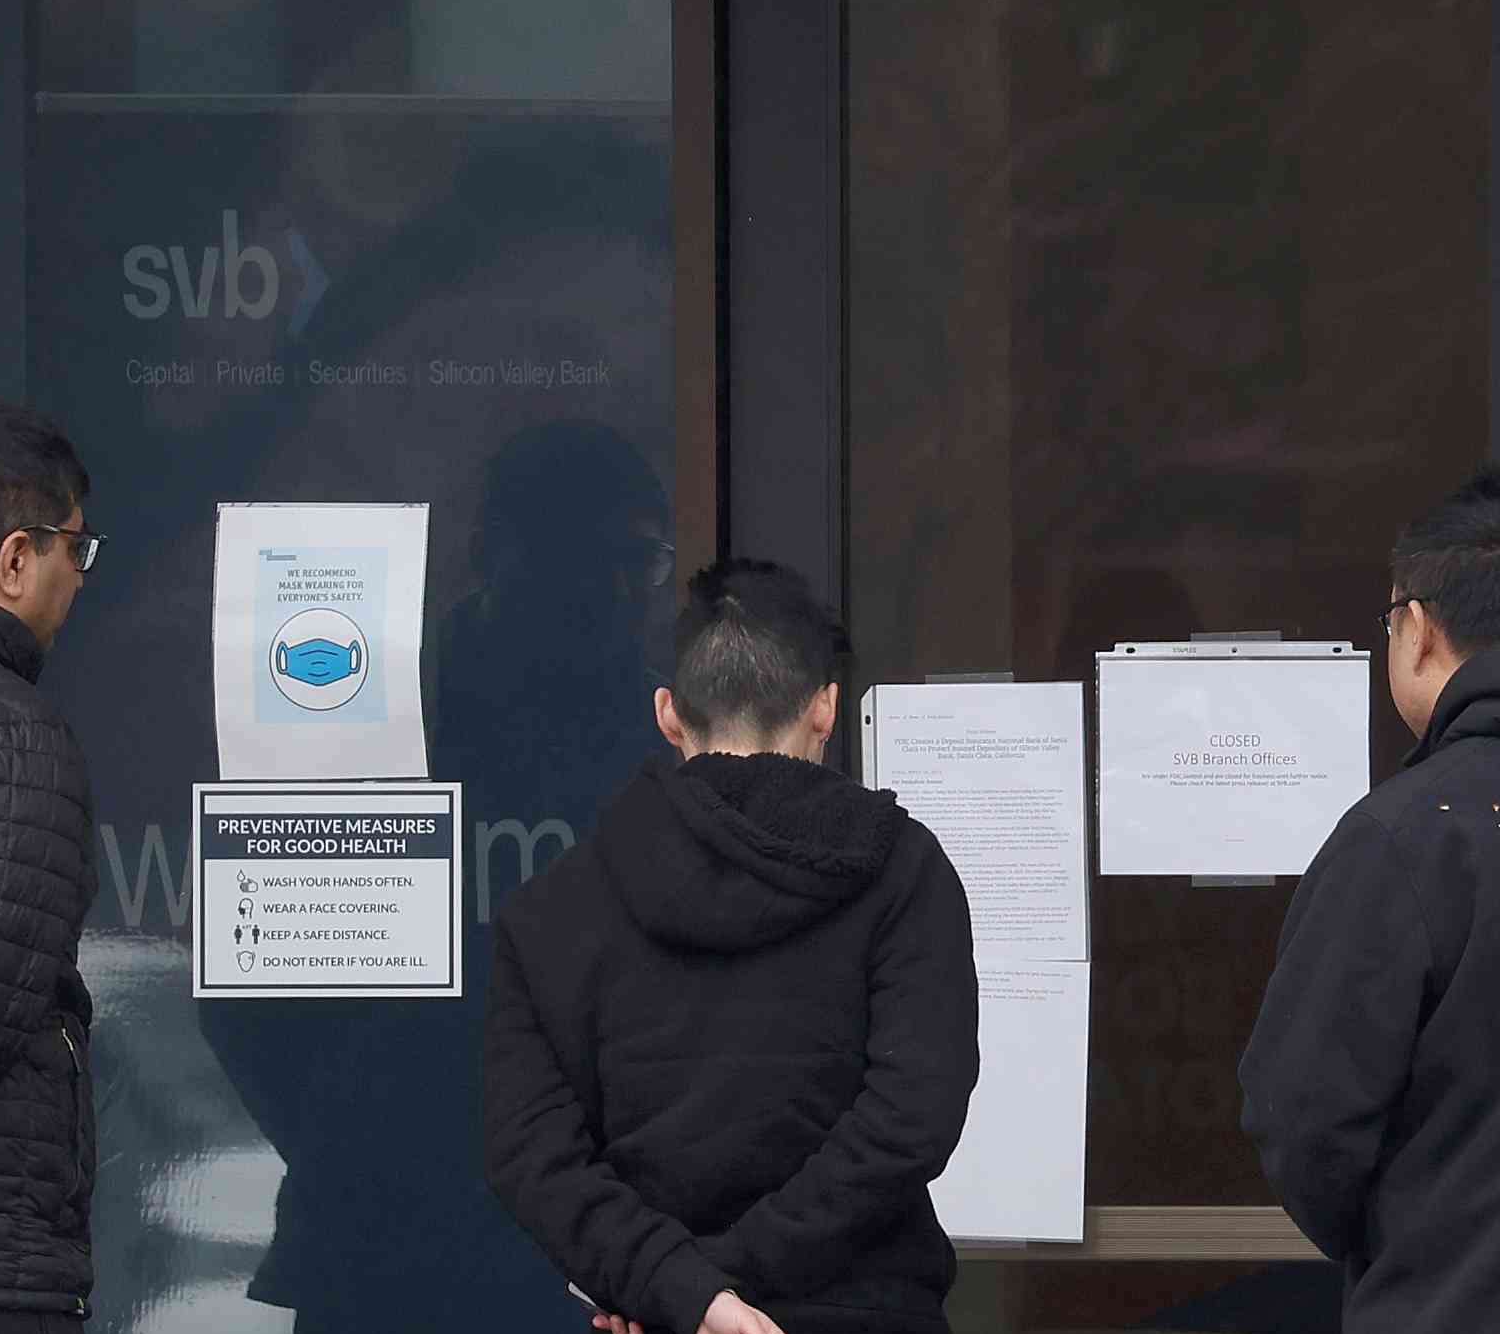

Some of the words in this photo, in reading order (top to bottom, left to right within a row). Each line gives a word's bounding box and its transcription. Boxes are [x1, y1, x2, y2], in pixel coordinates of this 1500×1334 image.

[123, 209, 280, 320] svb
[125, 359, 195, 387] Capital
[216, 360, 285, 385] Private
[308, 360, 407, 385] Securities
[428, 360, 495, 385] Silicon
[500, 360, 555, 389] Valley
[560, 359, 610, 385] Bank
[287, 569, 300, 578] WE
[302, 569, 356, 578] RECOMMEND
[278, 581, 302, 590] MASK
[305, 581, 344, 590] WEARING
[347, 580, 364, 589] FOR
[277, 593, 329, 602] EVERYONE'S
[331, 592, 363, 601] SAFETY.
[1209, 734, 1261, 748] CLOSED
[1173, 753, 1199, 766] SVB
[1202, 753, 1248, 766] Branch
[1251, 752, 1297, 766] Offices
[218, 819, 342, 834] PREVENTATIVE
[346, 819, 436, 834] MEASURES
[247, 839, 281, 854] FOR
[284, 839, 338, 854] GOOD
[341, 839, 406, 854] HEALTH
[262, 877, 297, 888] WASH
[299, 877, 331, 887] YOUR
[333, 877, 373, 887] HANDS
[375, 877, 415, 887] OFTEN.
[262, 903, 297, 914] WEAR
[299, 904, 307, 914] A
[309, 903, 337, 914] FACE
[338, 903, 400, 914] COVERING.
[262, 930, 292, 940] KEEP
[293, 930, 301, 940] A
[303, 930, 331, 940] SAFE
[332, 930, 390, 940] DISTANCE.
[262, 956, 280, 967] DO
[282, 957, 306, 967] NOT
[308, 957, 345, 967] ENTER
[347, 957, 357, 967] IF
[358, 957, 383, 967] YOU
[384, 957, 407, 967] ARE
[409, 957, 427, 967] ILL.
